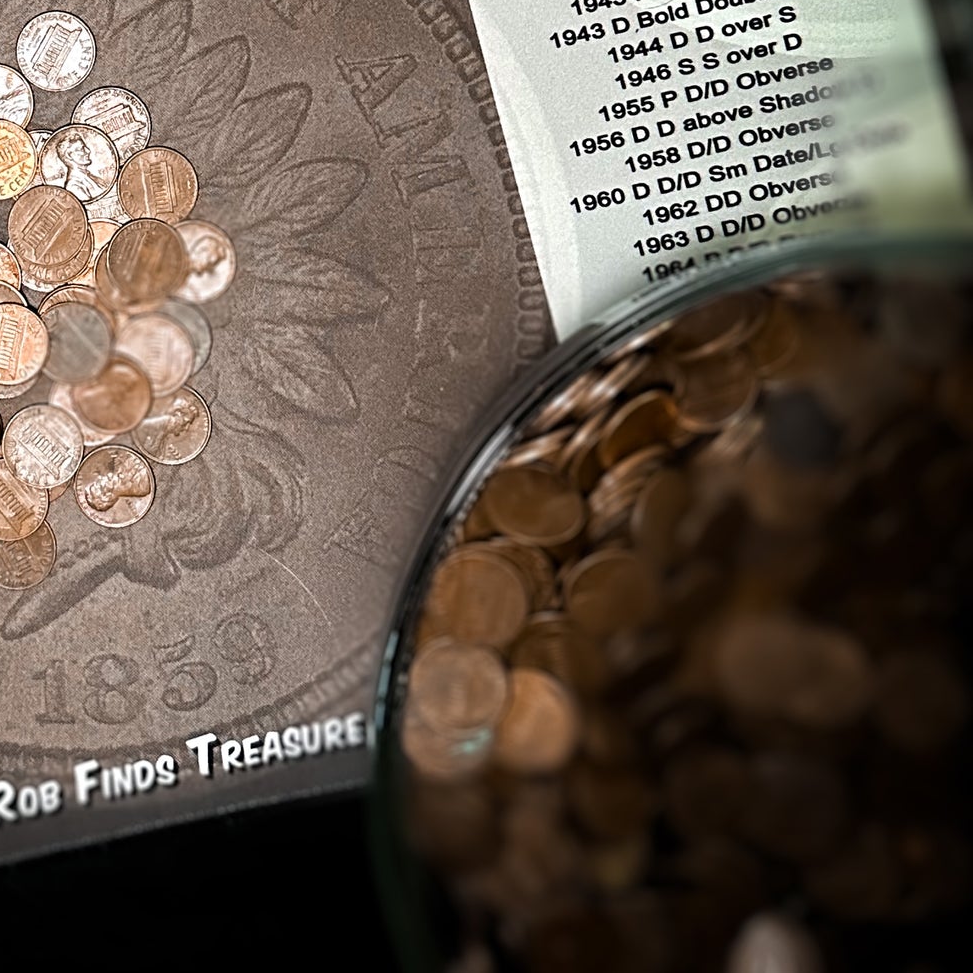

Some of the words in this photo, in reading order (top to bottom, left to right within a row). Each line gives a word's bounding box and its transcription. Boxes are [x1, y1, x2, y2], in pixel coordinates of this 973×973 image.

[550, 23, 605, 48] 1943
[611, 16, 630, 34] D
[637, 2, 689, 29] Bold
[608, 37, 663, 63] 1944
[670, 32, 688, 49] D
[695, 26, 714, 43] D
[722, 14, 772, 36] over
[779, 6, 796, 23] S
[615, 64, 671, 89] 1946
[678, 58, 695, 75] S
[702, 53, 720, 69] S
[727, 42, 777, 64] over
[783, 34, 802, 51] D
[599, 96, 655, 122] 1955
[661, 91, 677, 108] P
[684, 79, 729, 102] D/D
[736, 58, 834, 90] Obverse
[570, 131, 625, 156] 1956
[631, 126, 650, 143] D
[656, 120, 675, 137] D
[683, 106, 753, 131] above
[625, 147, 681, 172] 1958
[687, 136, 731, 159] D/D
[738, 114, 835, 146] Obverse
[570, 188, 625, 213] 1960
[632, 183, 650, 200] D
[657, 171, 701, 194] D/D
[709, 164, 747, 182] Sm
[643, 200, 699, 225] 1962
[705, 191, 742, 212] DD
[634, 231, 690, 256] 1963
[695, 225, 715, 243] D
[721, 214, 765, 237] D/D
[773, 192, 865, 224] Obve
[185, 711, 375, 777] TREASURE
